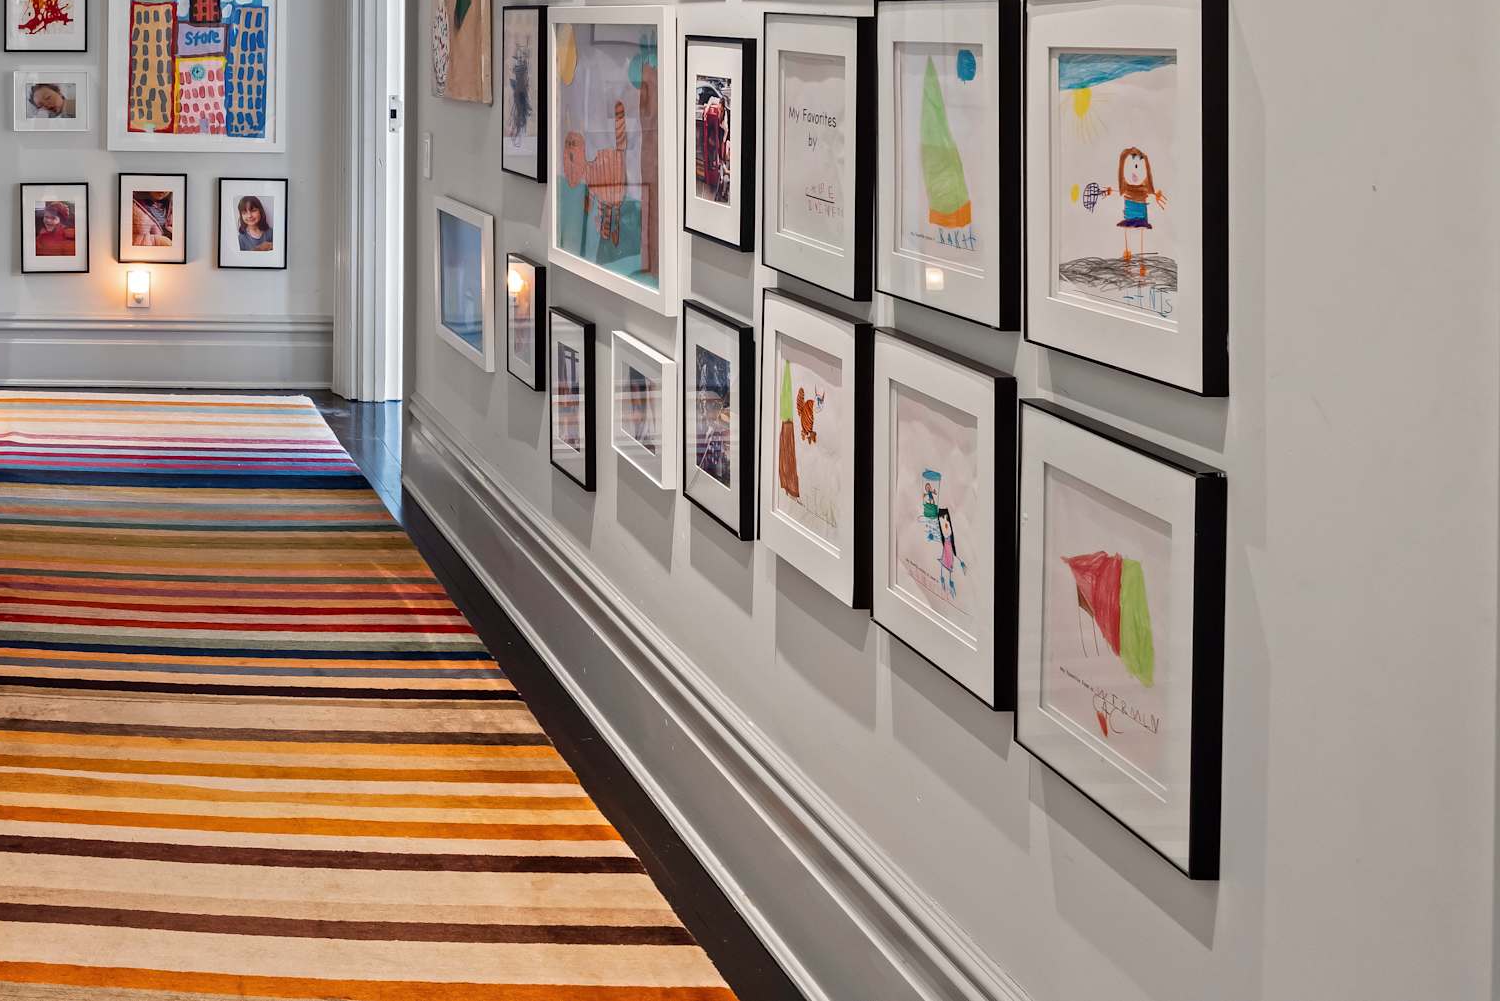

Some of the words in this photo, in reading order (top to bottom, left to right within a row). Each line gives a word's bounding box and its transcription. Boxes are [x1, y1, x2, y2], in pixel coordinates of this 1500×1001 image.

[185, 30, 221, 47] Store
[788, 106, 800, 123] My
[802, 108, 837, 128] Favorites
[808, 130, 818, 152] by
